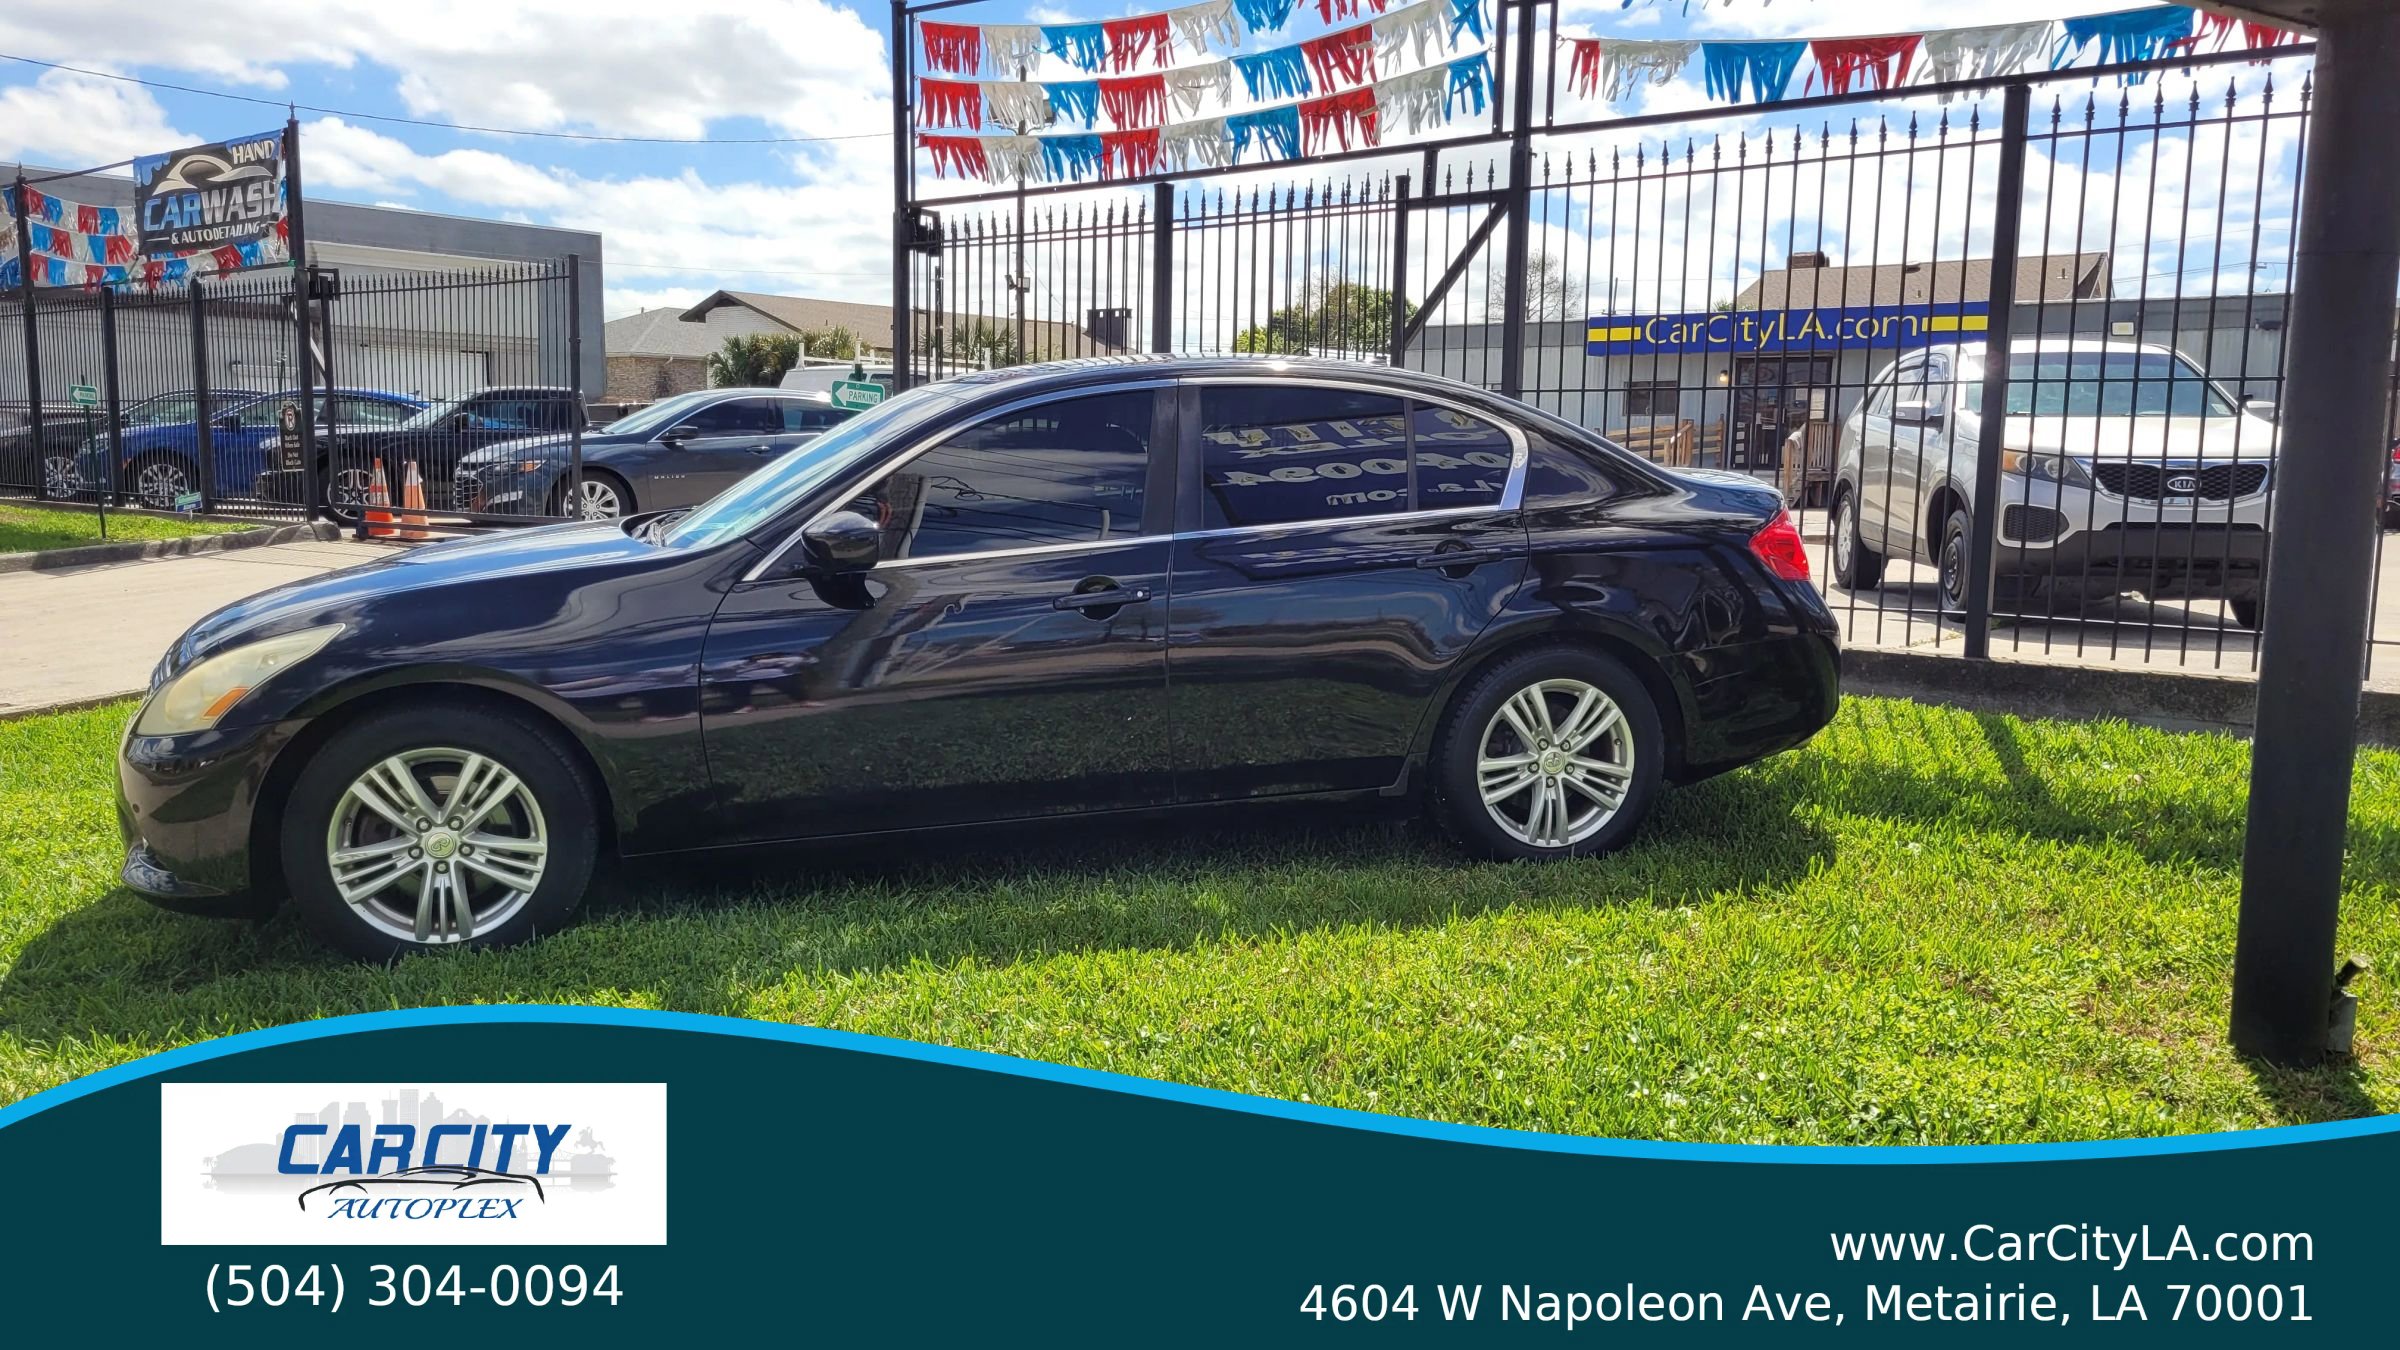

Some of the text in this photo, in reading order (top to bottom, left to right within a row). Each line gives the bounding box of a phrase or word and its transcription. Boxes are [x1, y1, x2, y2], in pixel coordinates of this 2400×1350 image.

[231, 140, 274, 165] HAND
[171, 232, 179, 245] &
[1645, 311, 1918, 350] CarCityLA.com
[848, 390, 878, 404] PARKING
